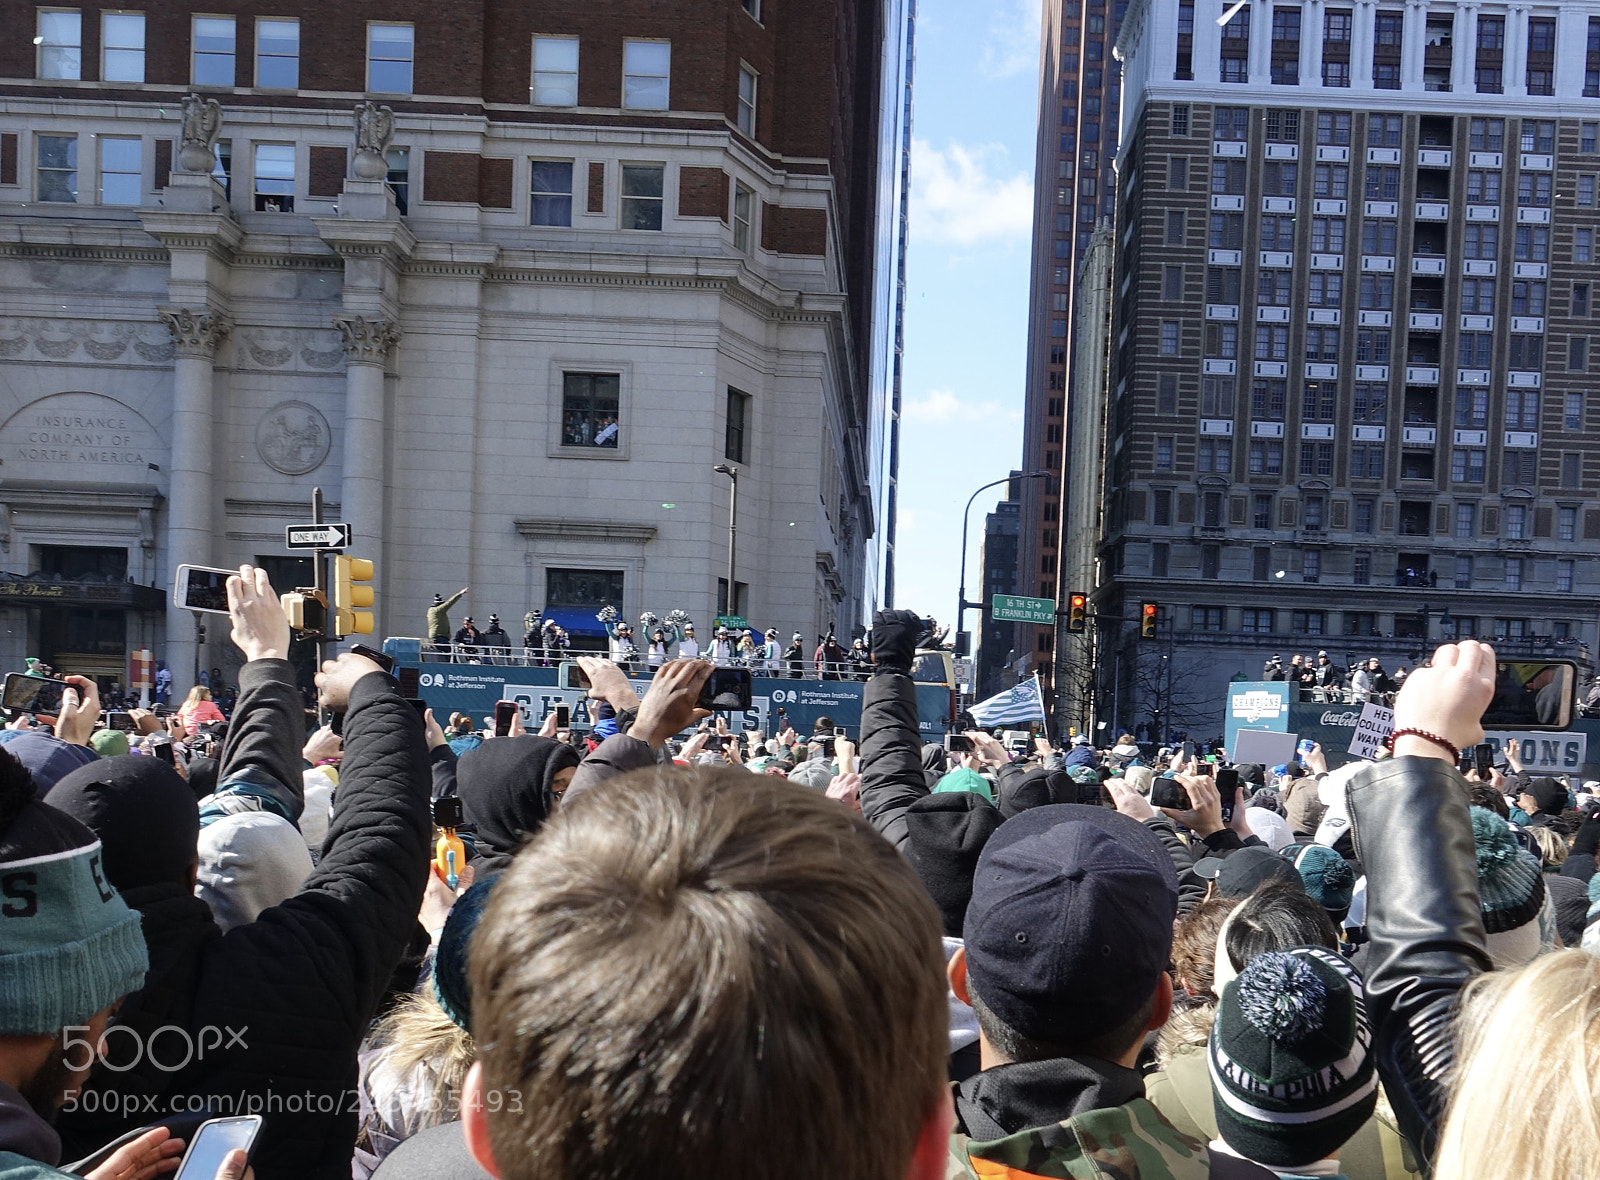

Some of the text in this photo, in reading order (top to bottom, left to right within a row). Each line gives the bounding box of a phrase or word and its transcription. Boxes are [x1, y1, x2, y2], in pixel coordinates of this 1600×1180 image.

[36, 416, 126, 429] INSURANCE
[28, 432, 131, 446] COMPANY OF
[19, 449, 144, 463] NORTH AMERICA
[294, 532, 329, 541] ONE WAY
[1027, 601, 1035, 609] ST
[994, 608, 1047, 620] B FRANKLIN PKY
[448, 674, 505, 683] Rothman Institute
[455, 682, 486, 690] Jefferson
[801, 690, 859, 700] Rothman Institute
[808, 698, 839, 706] Jefferson
[1374, 709, 1394, 722] HEY
[1357, 732, 1383, 746] WAN
